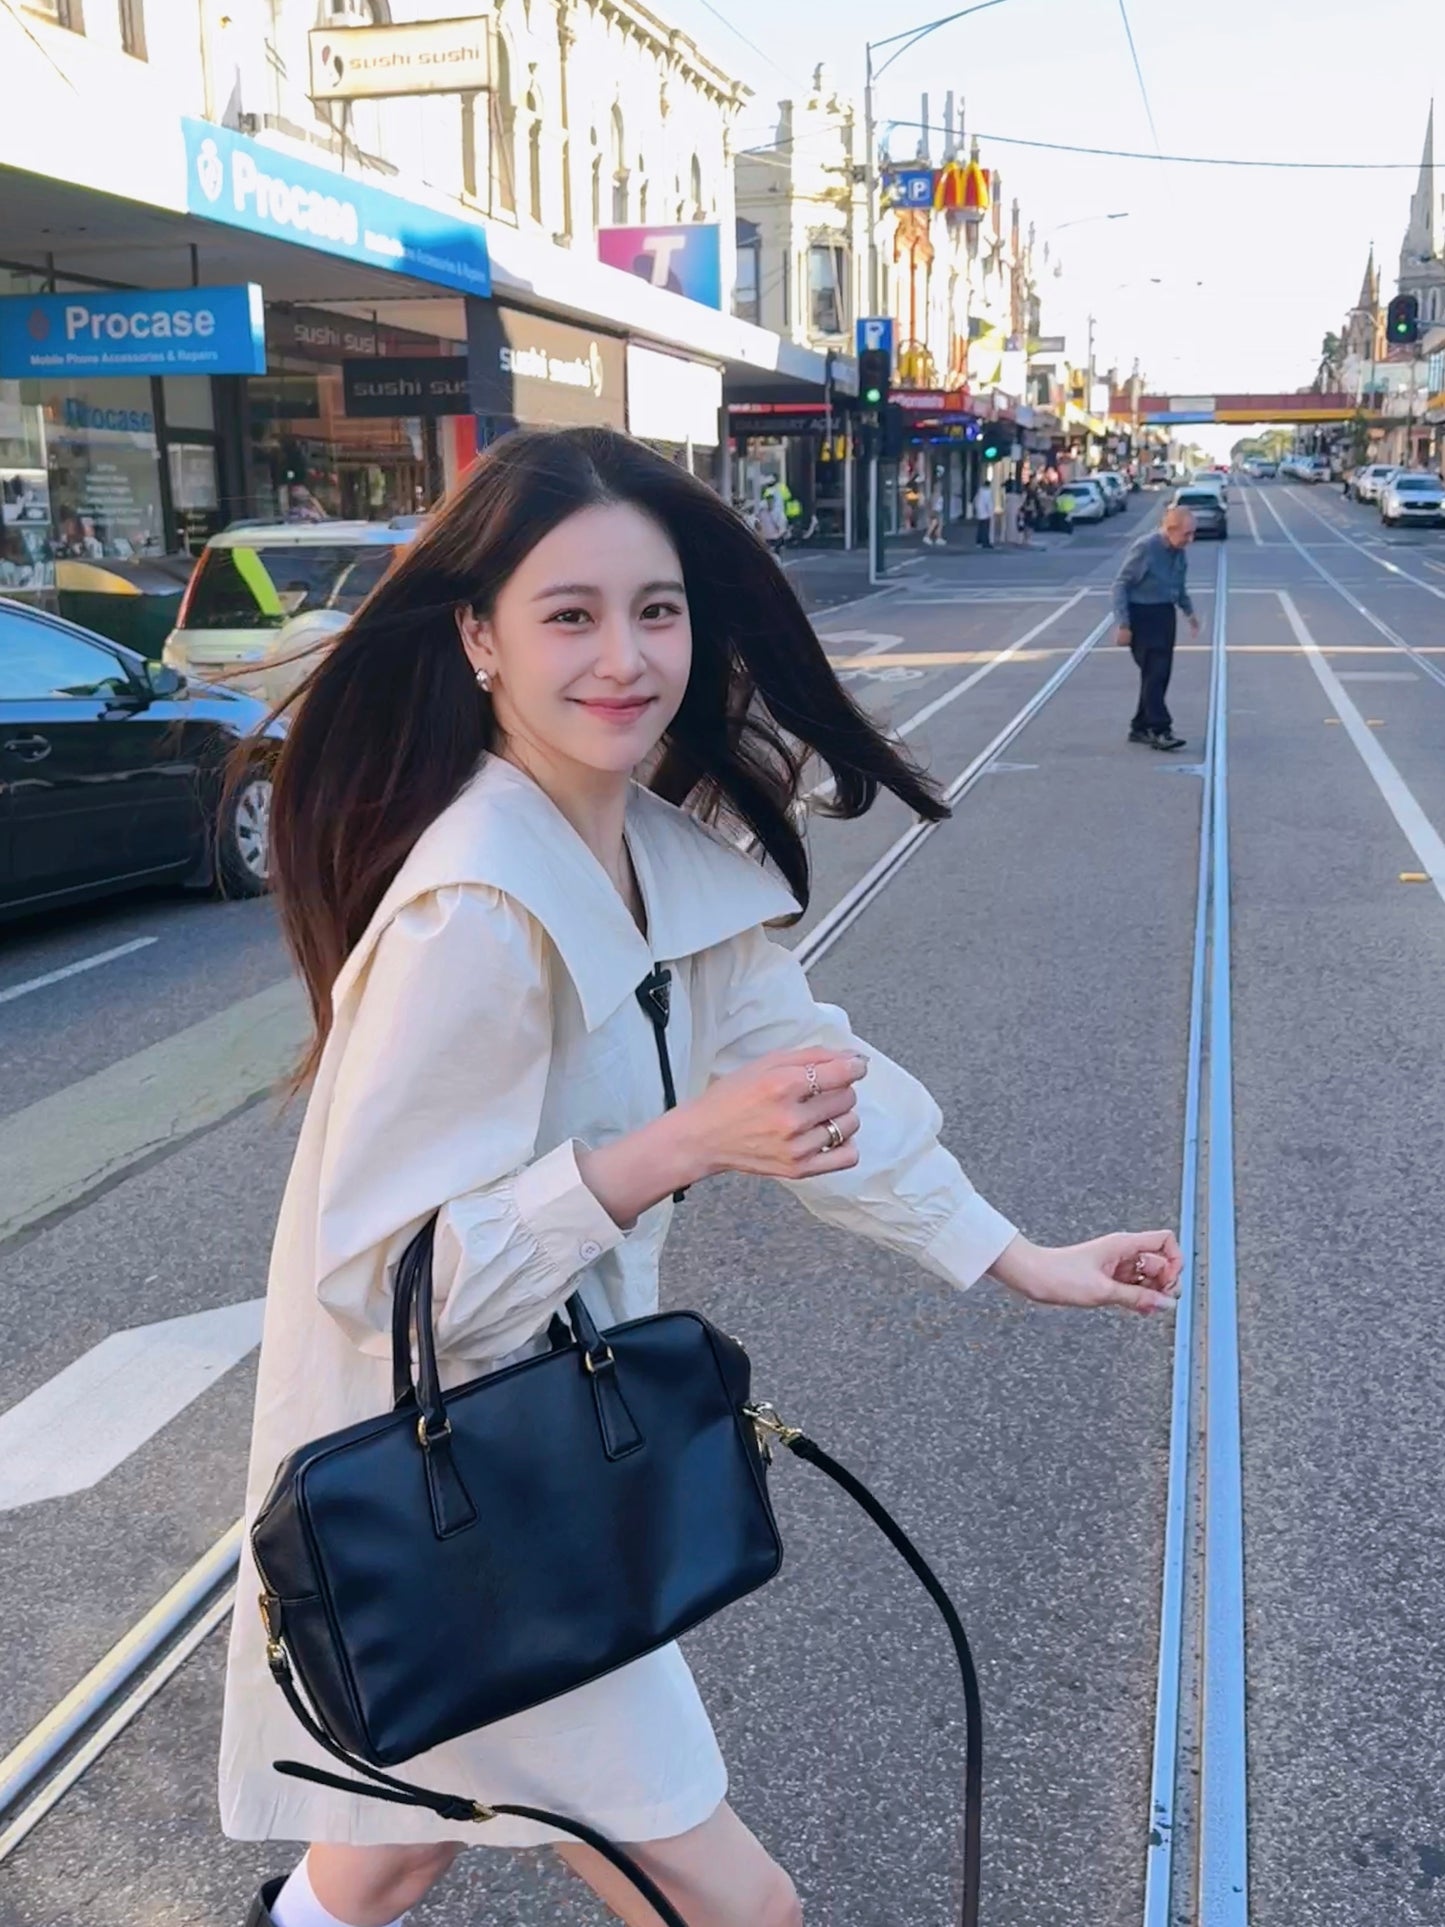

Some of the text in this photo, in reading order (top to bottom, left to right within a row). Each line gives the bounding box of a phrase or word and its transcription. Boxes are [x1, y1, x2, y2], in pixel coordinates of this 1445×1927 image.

[350, 45, 480, 70] sushi sushi
[912, 181, 928, 201] P
[642, 234, 687, 288] T
[65, 305, 216, 341] Procase
[293, 323, 341, 347] sushi
[30, 354, 64, 365] Mobile
[66, 352, 99, 364] Phone
[167, 350, 176, 362] &
[178, 348, 218, 363] Repairs
[353, 378, 421, 396] sushi
